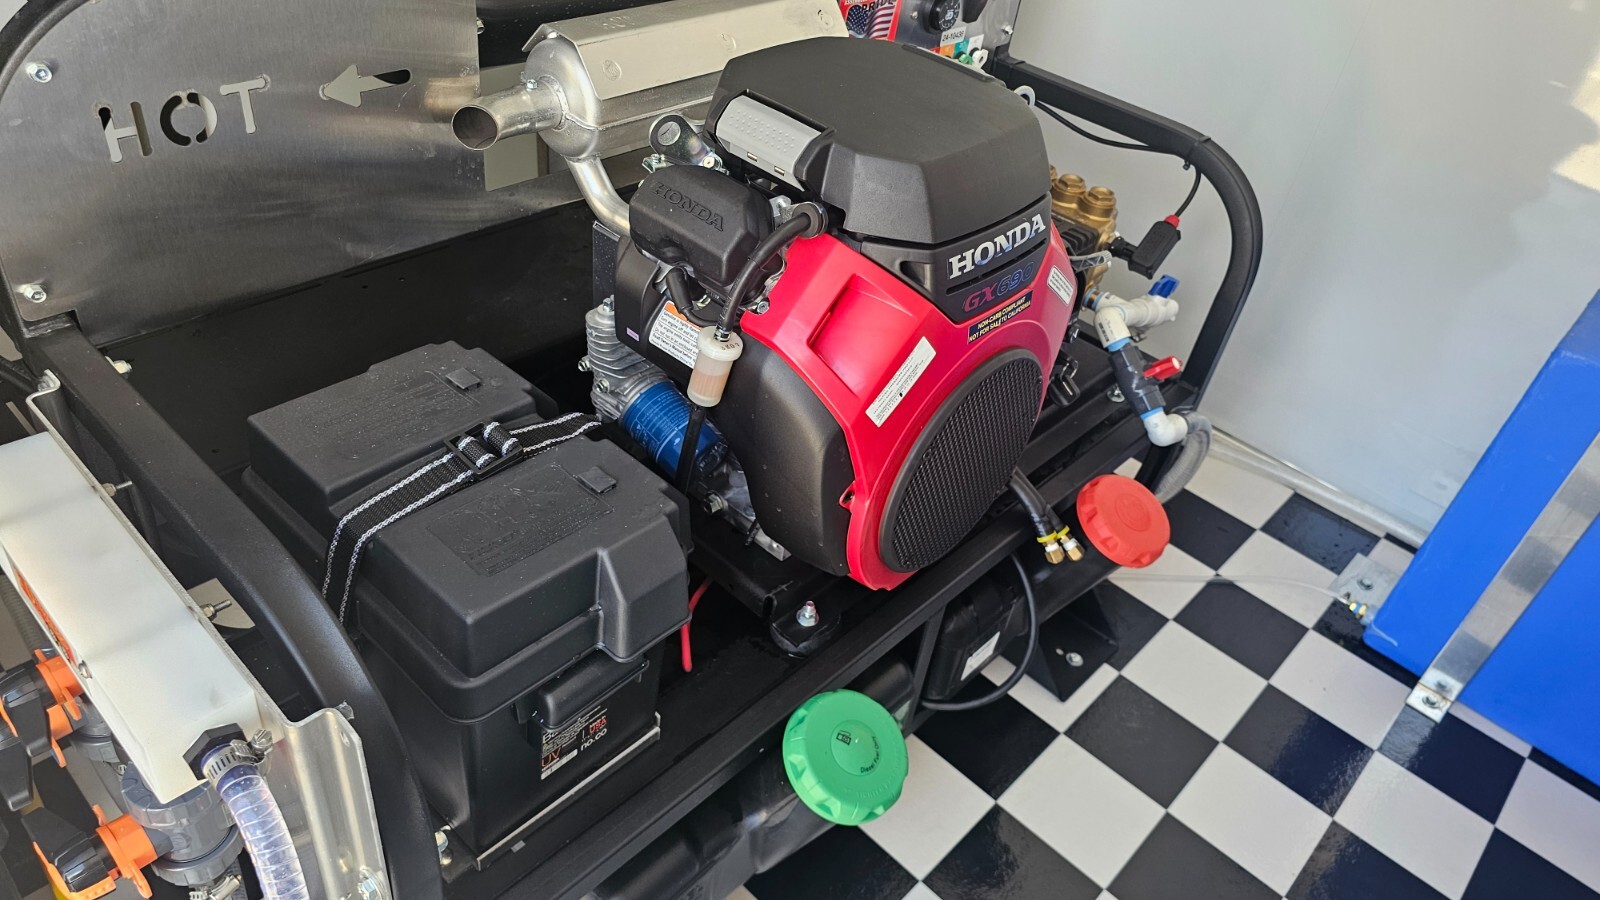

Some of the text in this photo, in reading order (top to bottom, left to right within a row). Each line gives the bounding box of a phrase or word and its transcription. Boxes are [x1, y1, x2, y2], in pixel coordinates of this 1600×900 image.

[98, 78, 267, 163] HOT
[653, 182, 724, 232] HONDA
[948, 213, 1046, 279] HONDA
[962, 261, 1034, 312] GX690
[968, 331, 980, 342] NOT
[589, 718, 607, 734] USA
